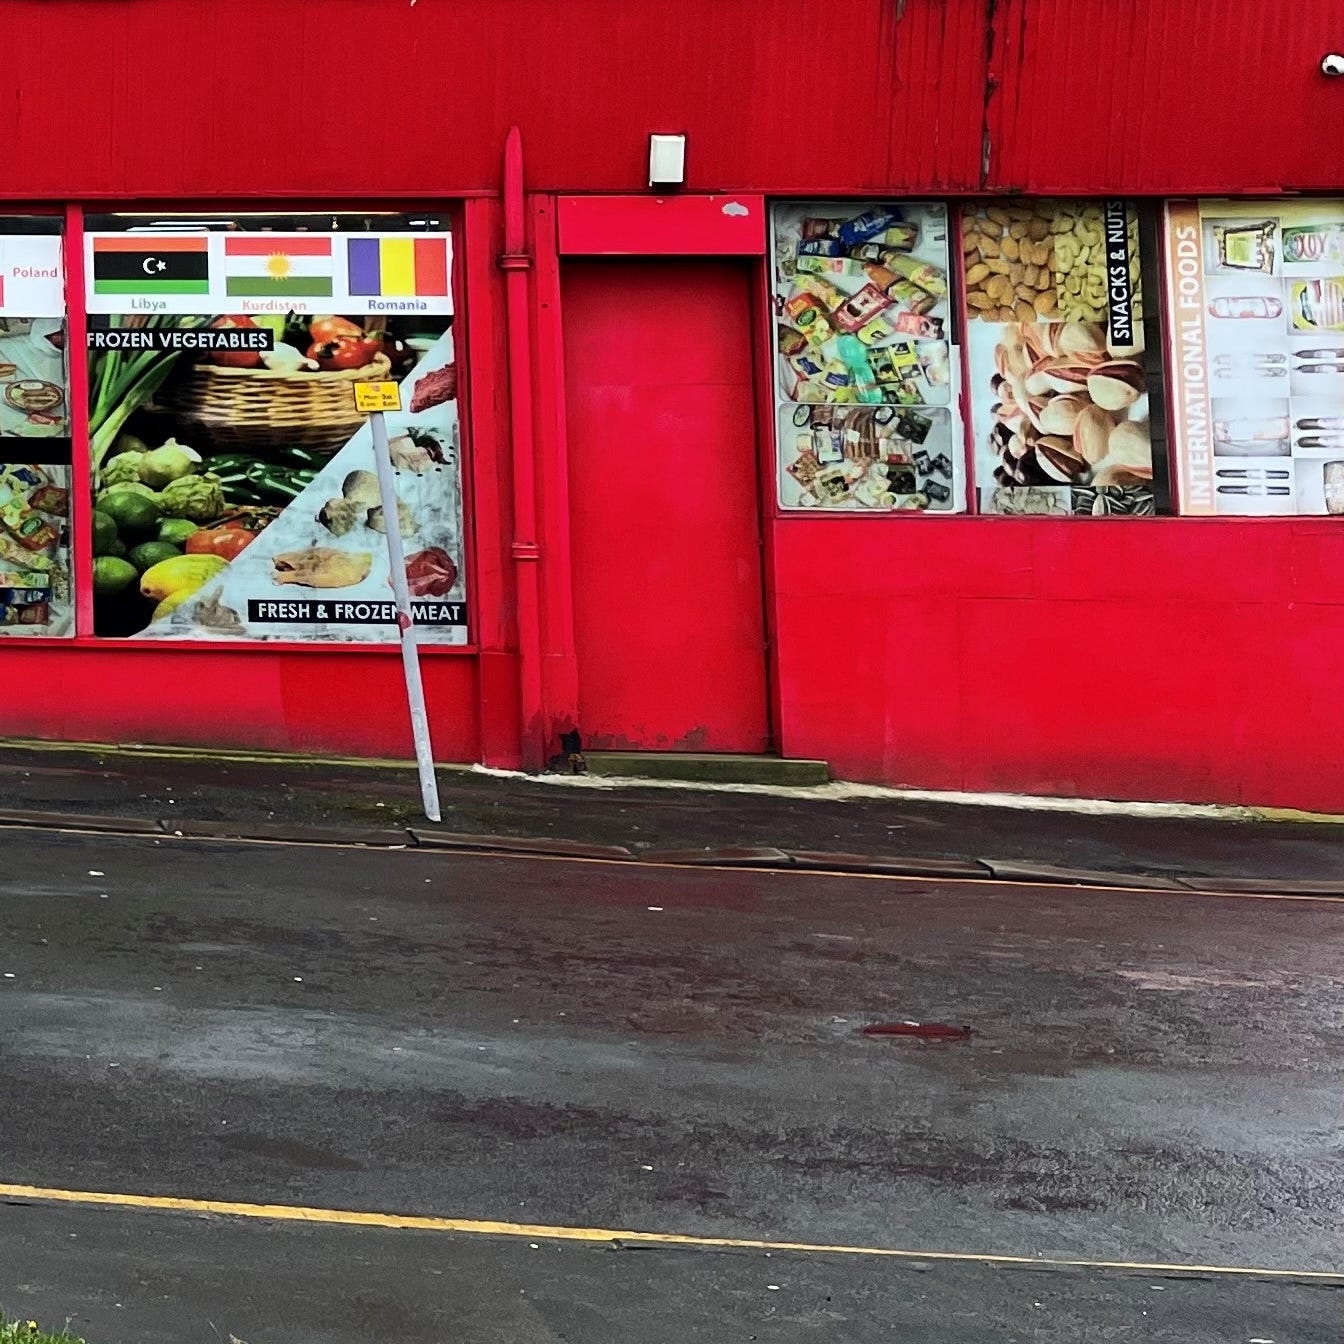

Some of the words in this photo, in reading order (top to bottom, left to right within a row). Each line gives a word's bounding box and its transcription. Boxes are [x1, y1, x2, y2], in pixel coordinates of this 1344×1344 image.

[1107, 200, 1125, 243] NUTS
[1110, 249, 1126, 261] &
[13, 267, 58, 278] Poland
[1176, 225, 1201, 309] FOODS
[131, 298, 167, 310] Libya
[242, 300, 307, 311] Kurdistan
[368, 299, 427, 311] Romania
[1110, 266, 1130, 339] SNACKS
[87, 332, 153, 348] FROZEN
[160, 332, 268, 349] VEGETABLES
[1181, 315, 1212, 505] INTERNATIONAL
[258, 603, 310, 618] FRESH
[316, 604, 329, 619] &
[335, 604, 400, 621] FROZEN
[411, 605, 460, 622] MEAT
